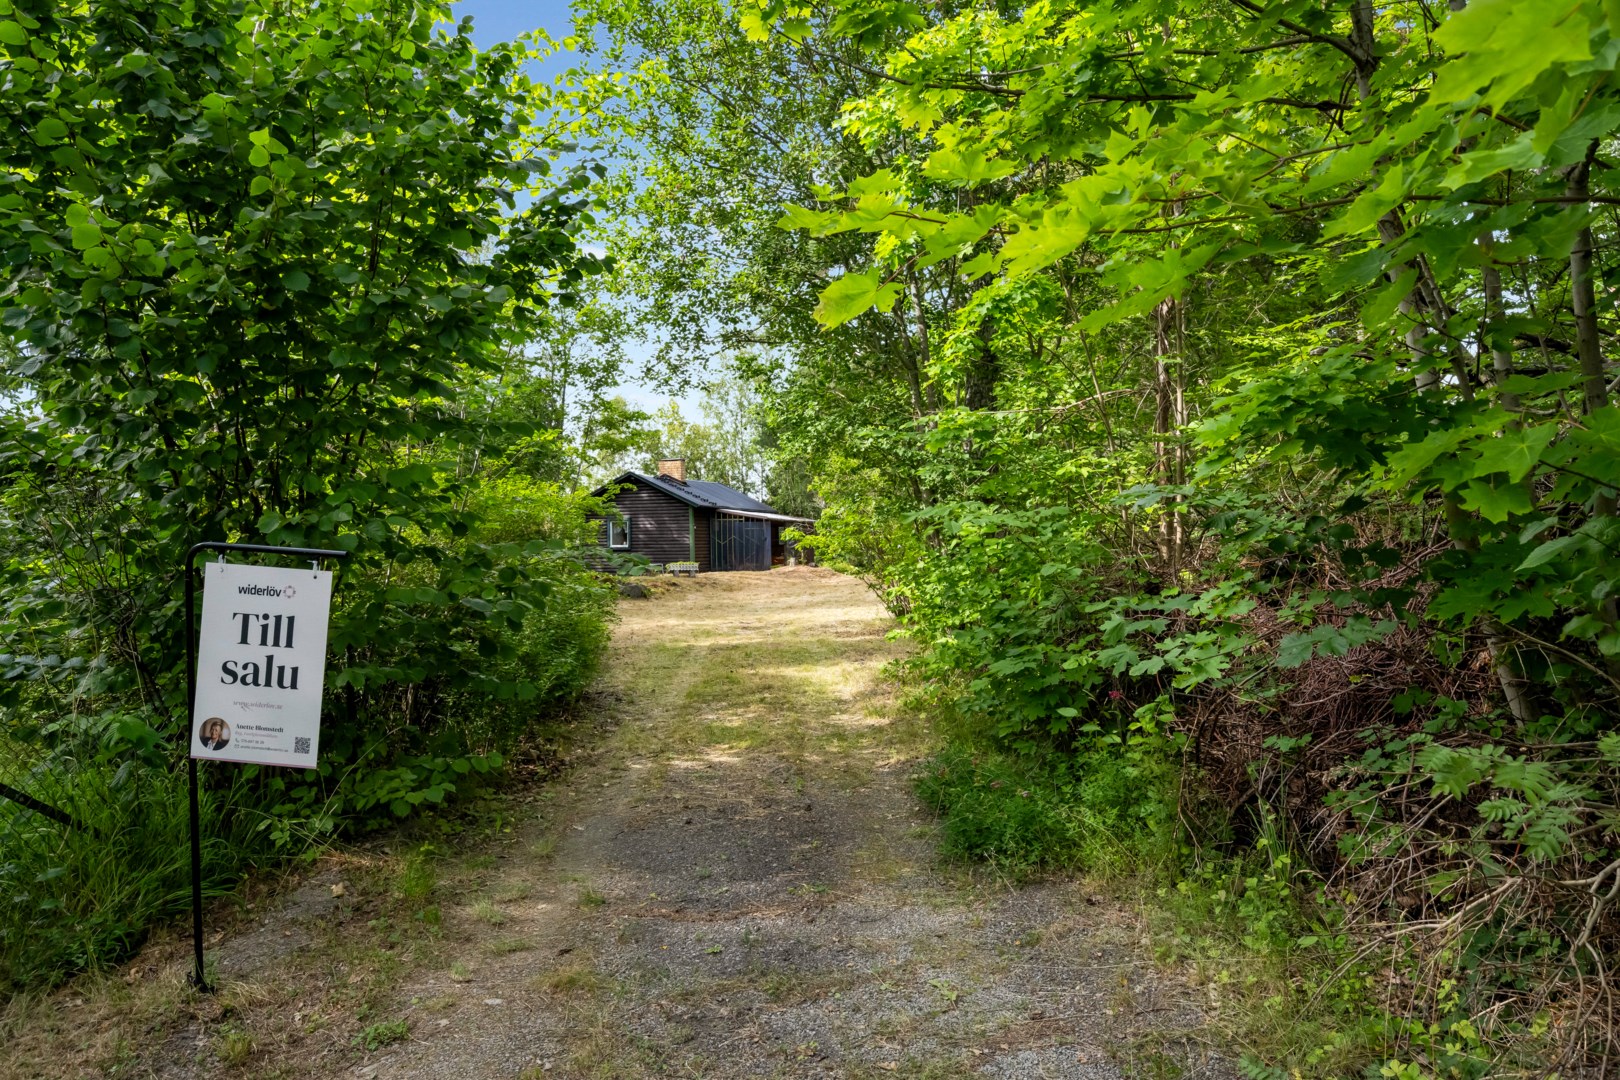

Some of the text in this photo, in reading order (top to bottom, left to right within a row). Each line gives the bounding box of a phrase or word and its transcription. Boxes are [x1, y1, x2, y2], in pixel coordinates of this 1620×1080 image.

[238, 584, 282, 597] widerlöv
[232, 612, 295, 649] Till
[220, 654, 299, 690] salu
[236, 723, 254, 731] Anette
